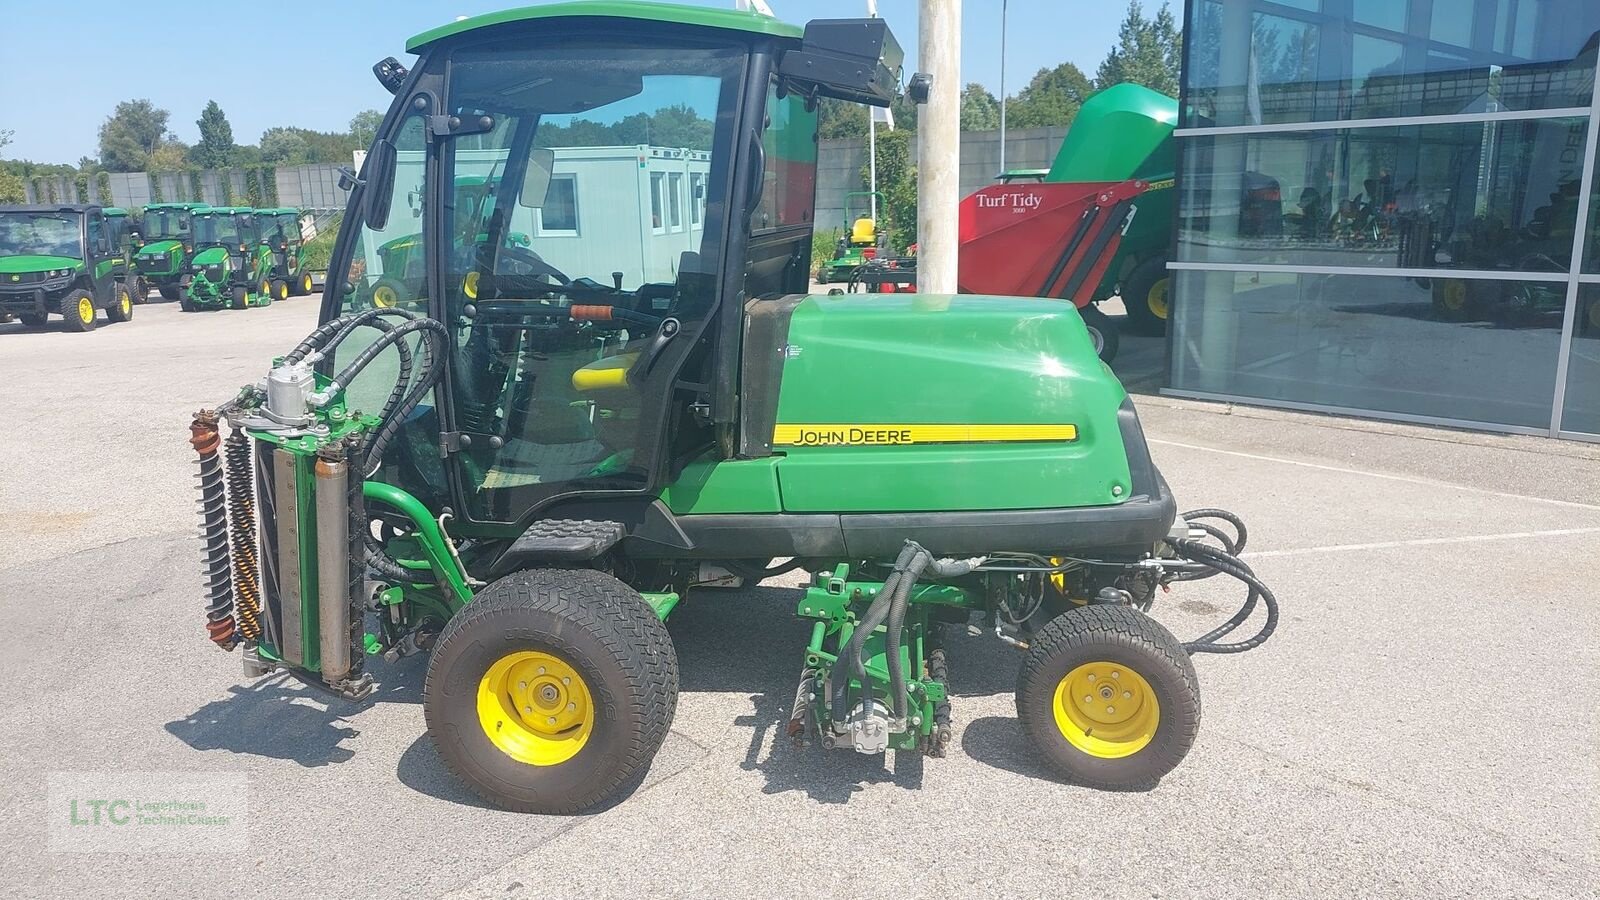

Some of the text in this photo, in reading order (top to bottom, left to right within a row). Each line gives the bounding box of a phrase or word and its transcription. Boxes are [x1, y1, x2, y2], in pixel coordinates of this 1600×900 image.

[976, 193, 1042, 209] Turf Tidy
[794, 428, 911, 443] JOHN DEERE
